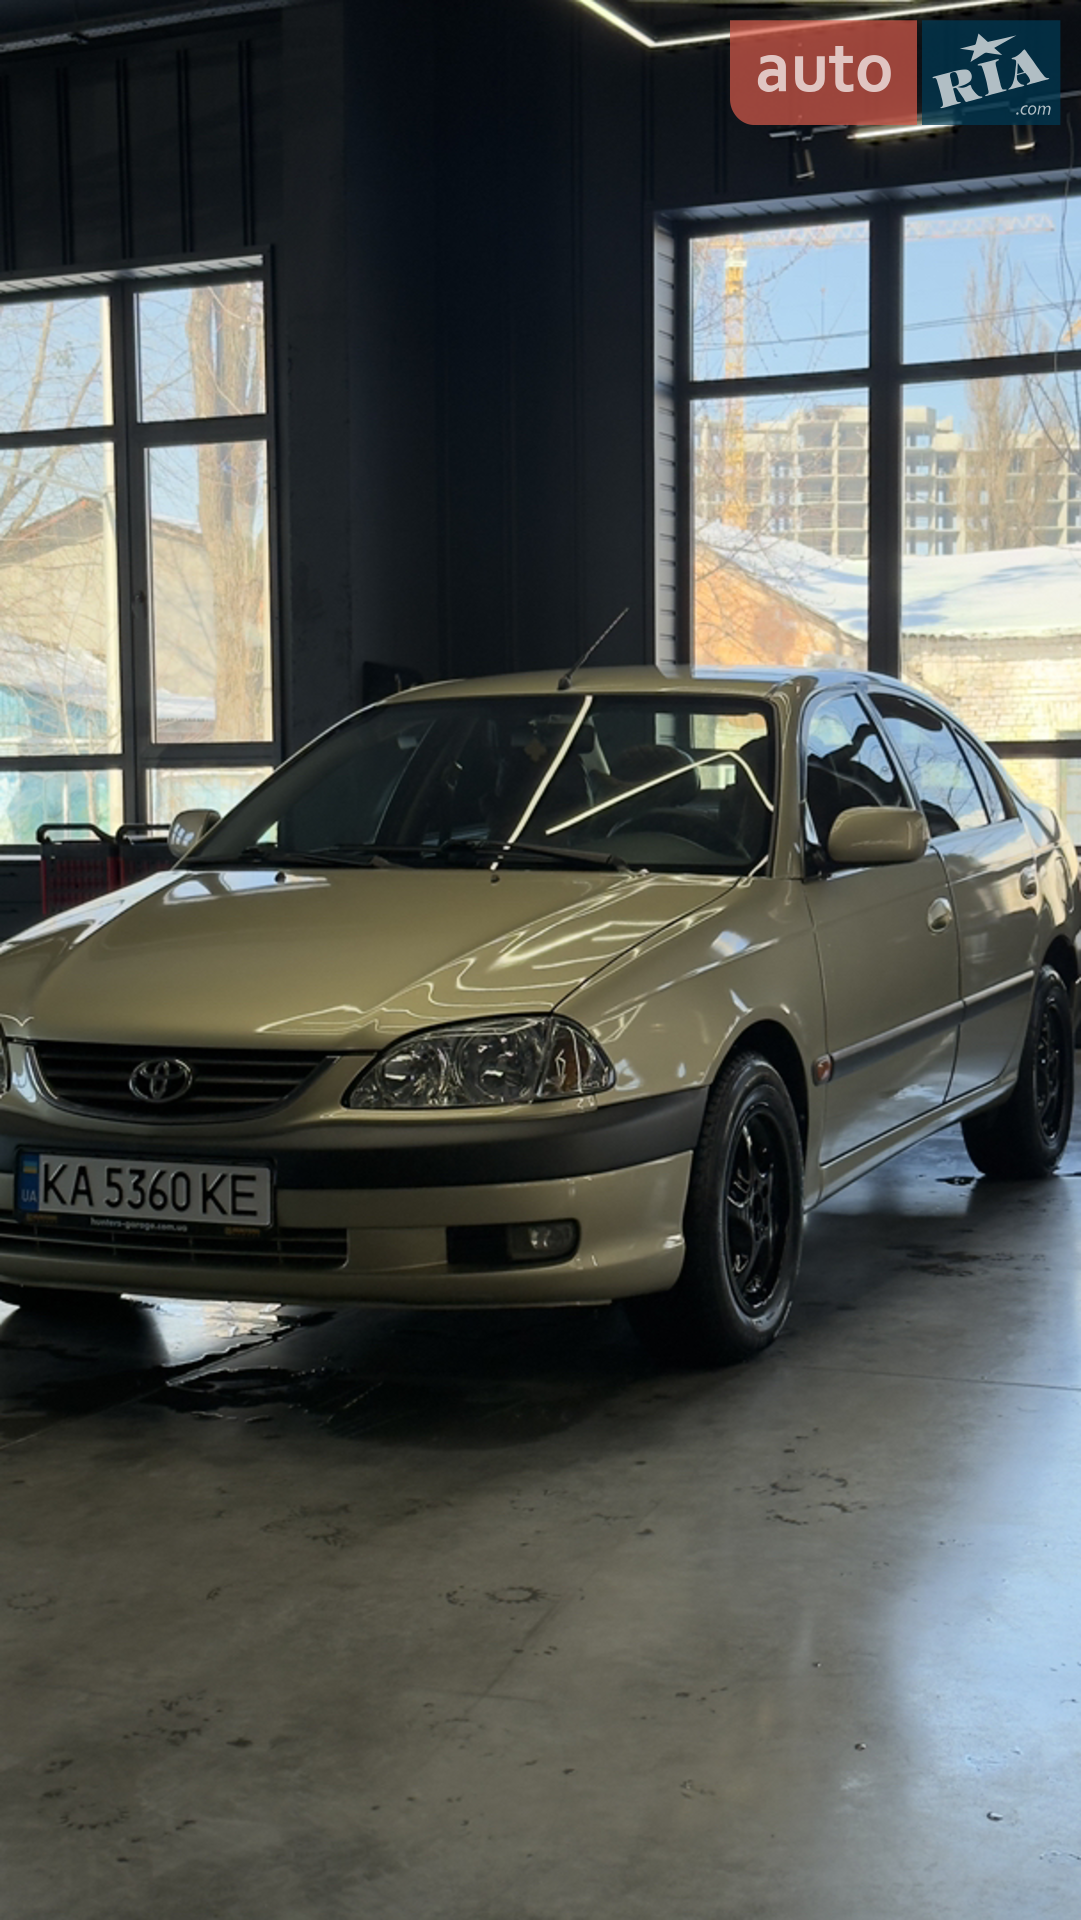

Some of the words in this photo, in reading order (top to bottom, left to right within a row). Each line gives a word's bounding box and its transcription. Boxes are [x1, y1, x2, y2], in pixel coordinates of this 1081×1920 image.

[21, 1189, 38, 1202] UA
[43, 1163, 94, 1207] KA
[104, 1167, 191, 1212] 5360
[202, 1173, 258, 1216] KE
[90, 1217, 188, 1232] hunters-garage.com.ua
